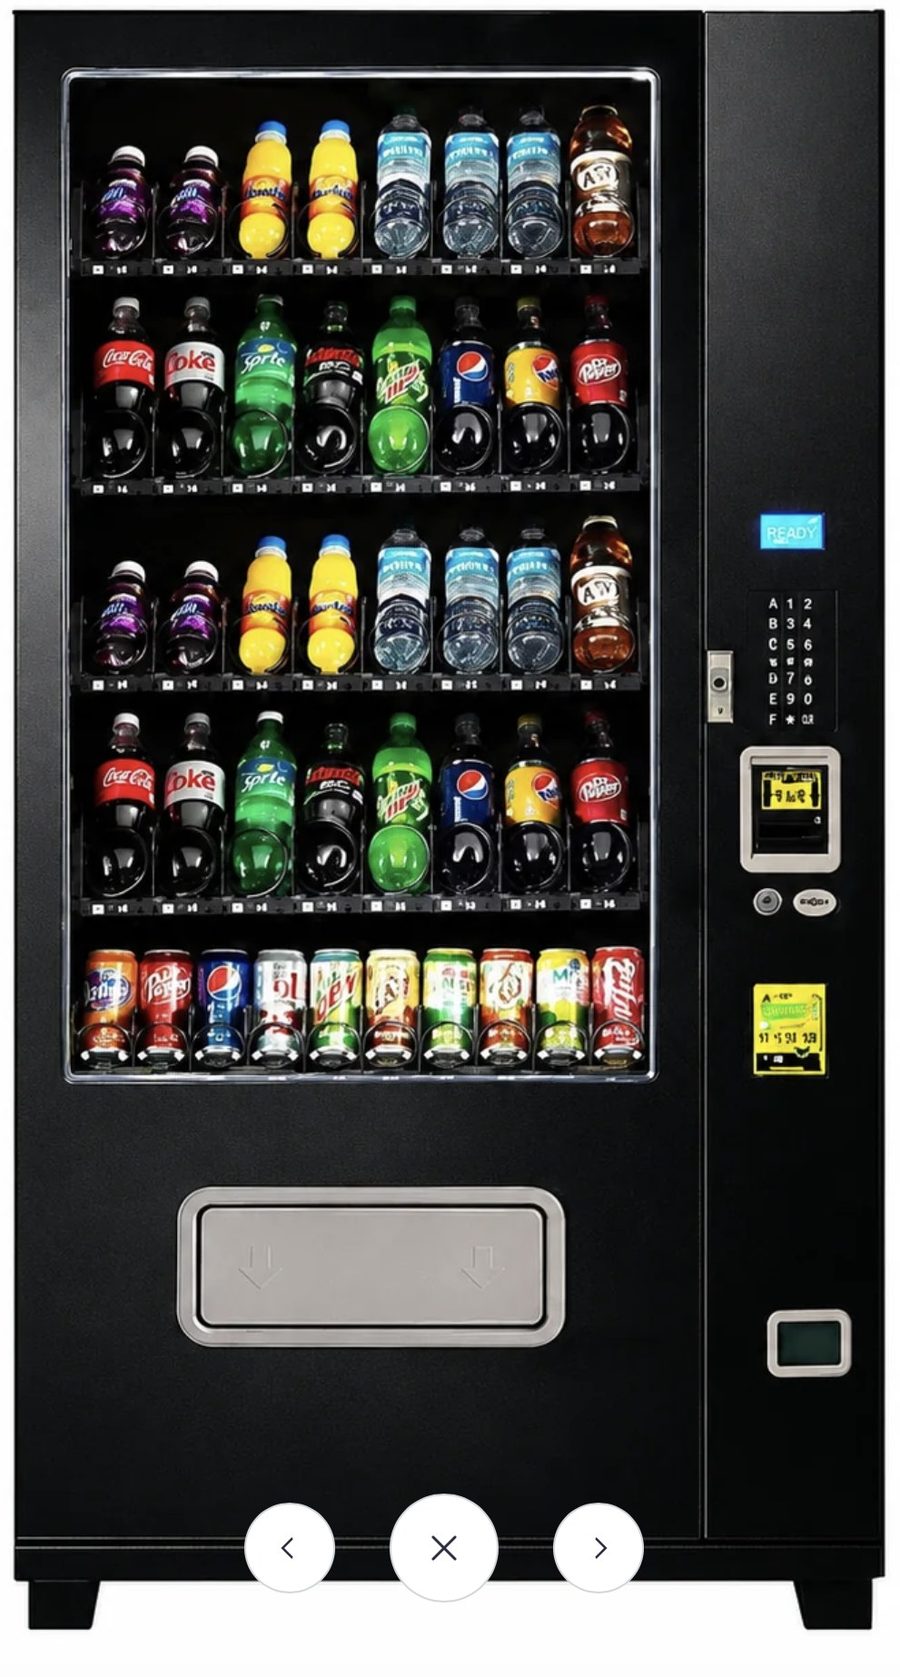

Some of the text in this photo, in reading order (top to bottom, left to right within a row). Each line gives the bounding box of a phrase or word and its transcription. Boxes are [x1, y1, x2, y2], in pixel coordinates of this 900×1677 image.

[767, 526, 817, 540] READY
[769, 597, 812, 610] A 1 2
[769, 617, 812, 630] B 3 4
[768, 637, 812, 651] C 5 6
[769, 672, 778, 684] D
[786, 671, 795, 685] 7
[769, 692, 812, 705] E 9 0
[769, 713, 777, 726] F
